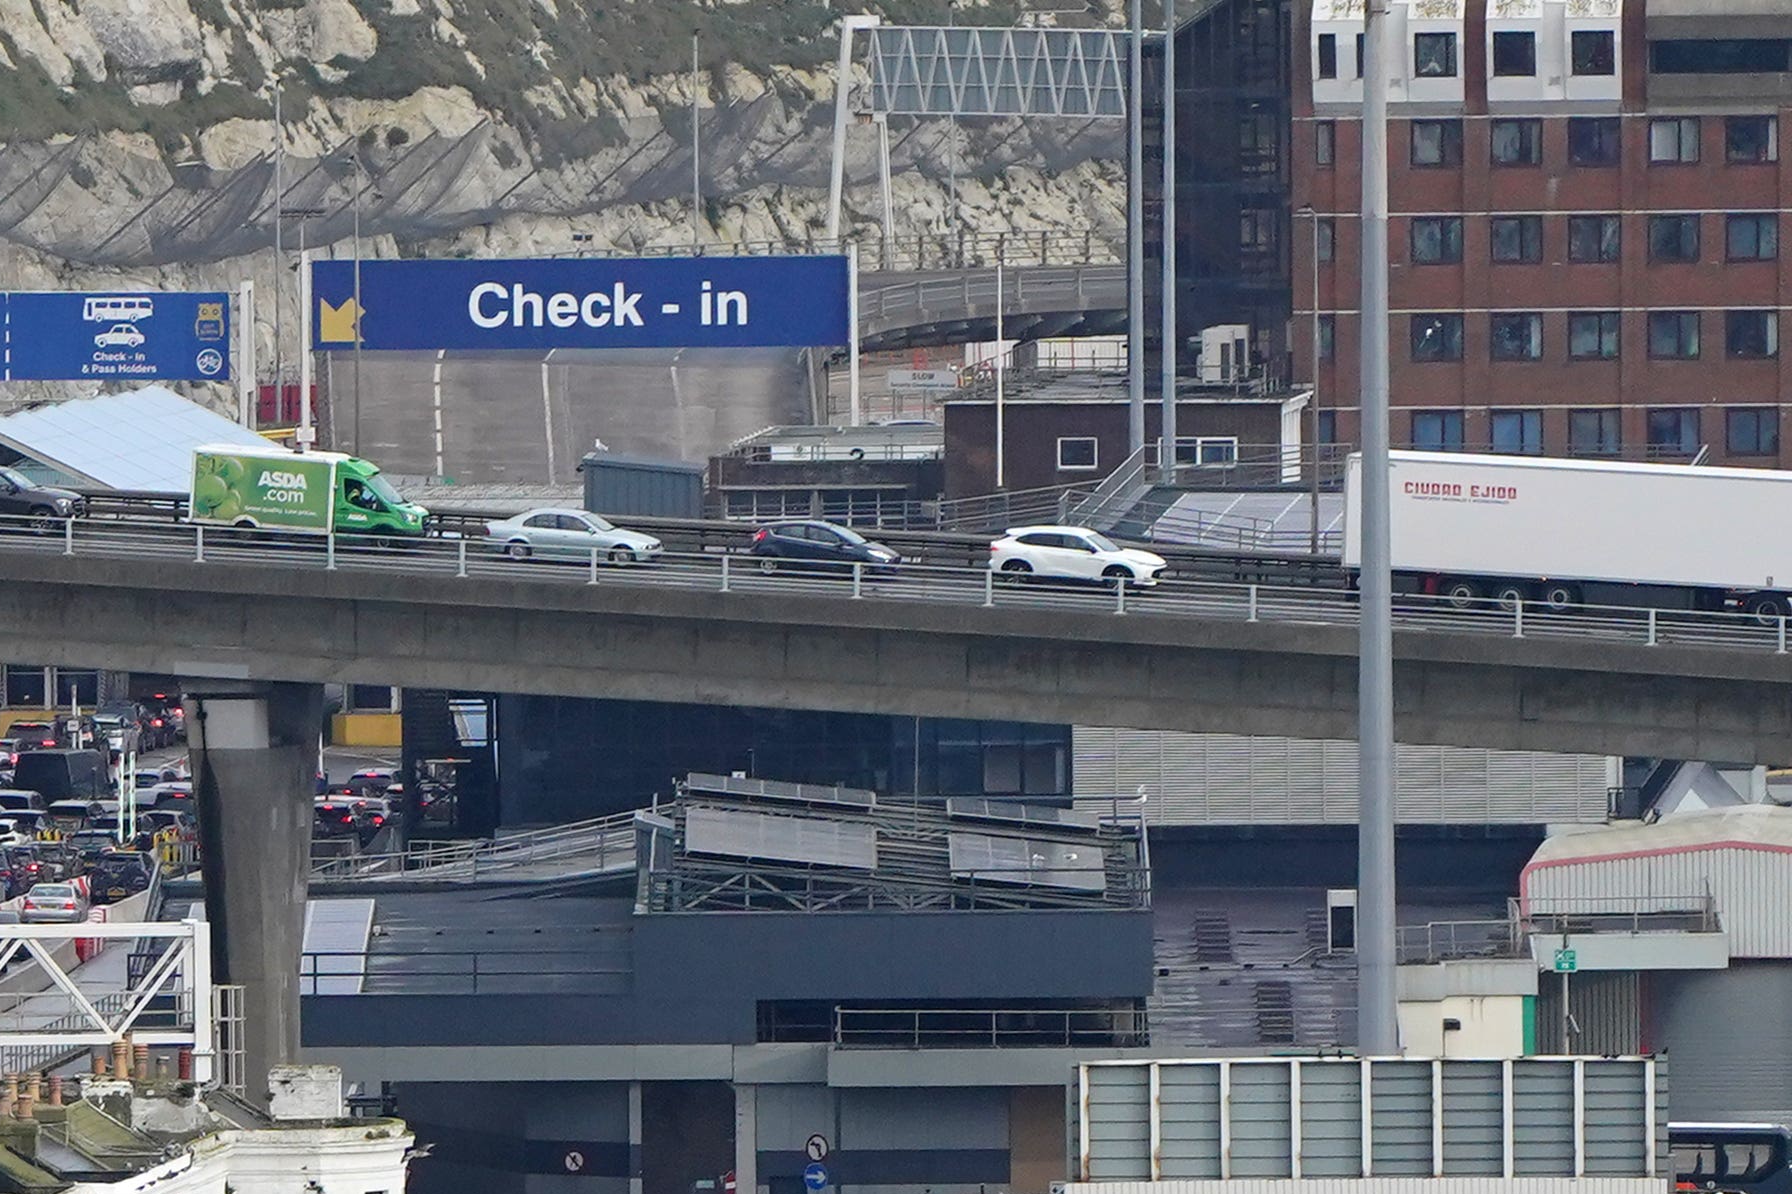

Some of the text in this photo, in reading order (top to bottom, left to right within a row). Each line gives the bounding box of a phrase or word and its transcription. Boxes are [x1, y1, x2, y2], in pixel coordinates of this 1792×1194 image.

[468, 280, 748, 329] Check - in
[93, 351, 123, 363] Check
[91, 364, 116, 375] Pass
[117, 364, 157, 374] Holders
[258, 471, 307, 490] ASDA
[263, 488, 304, 503] .com
